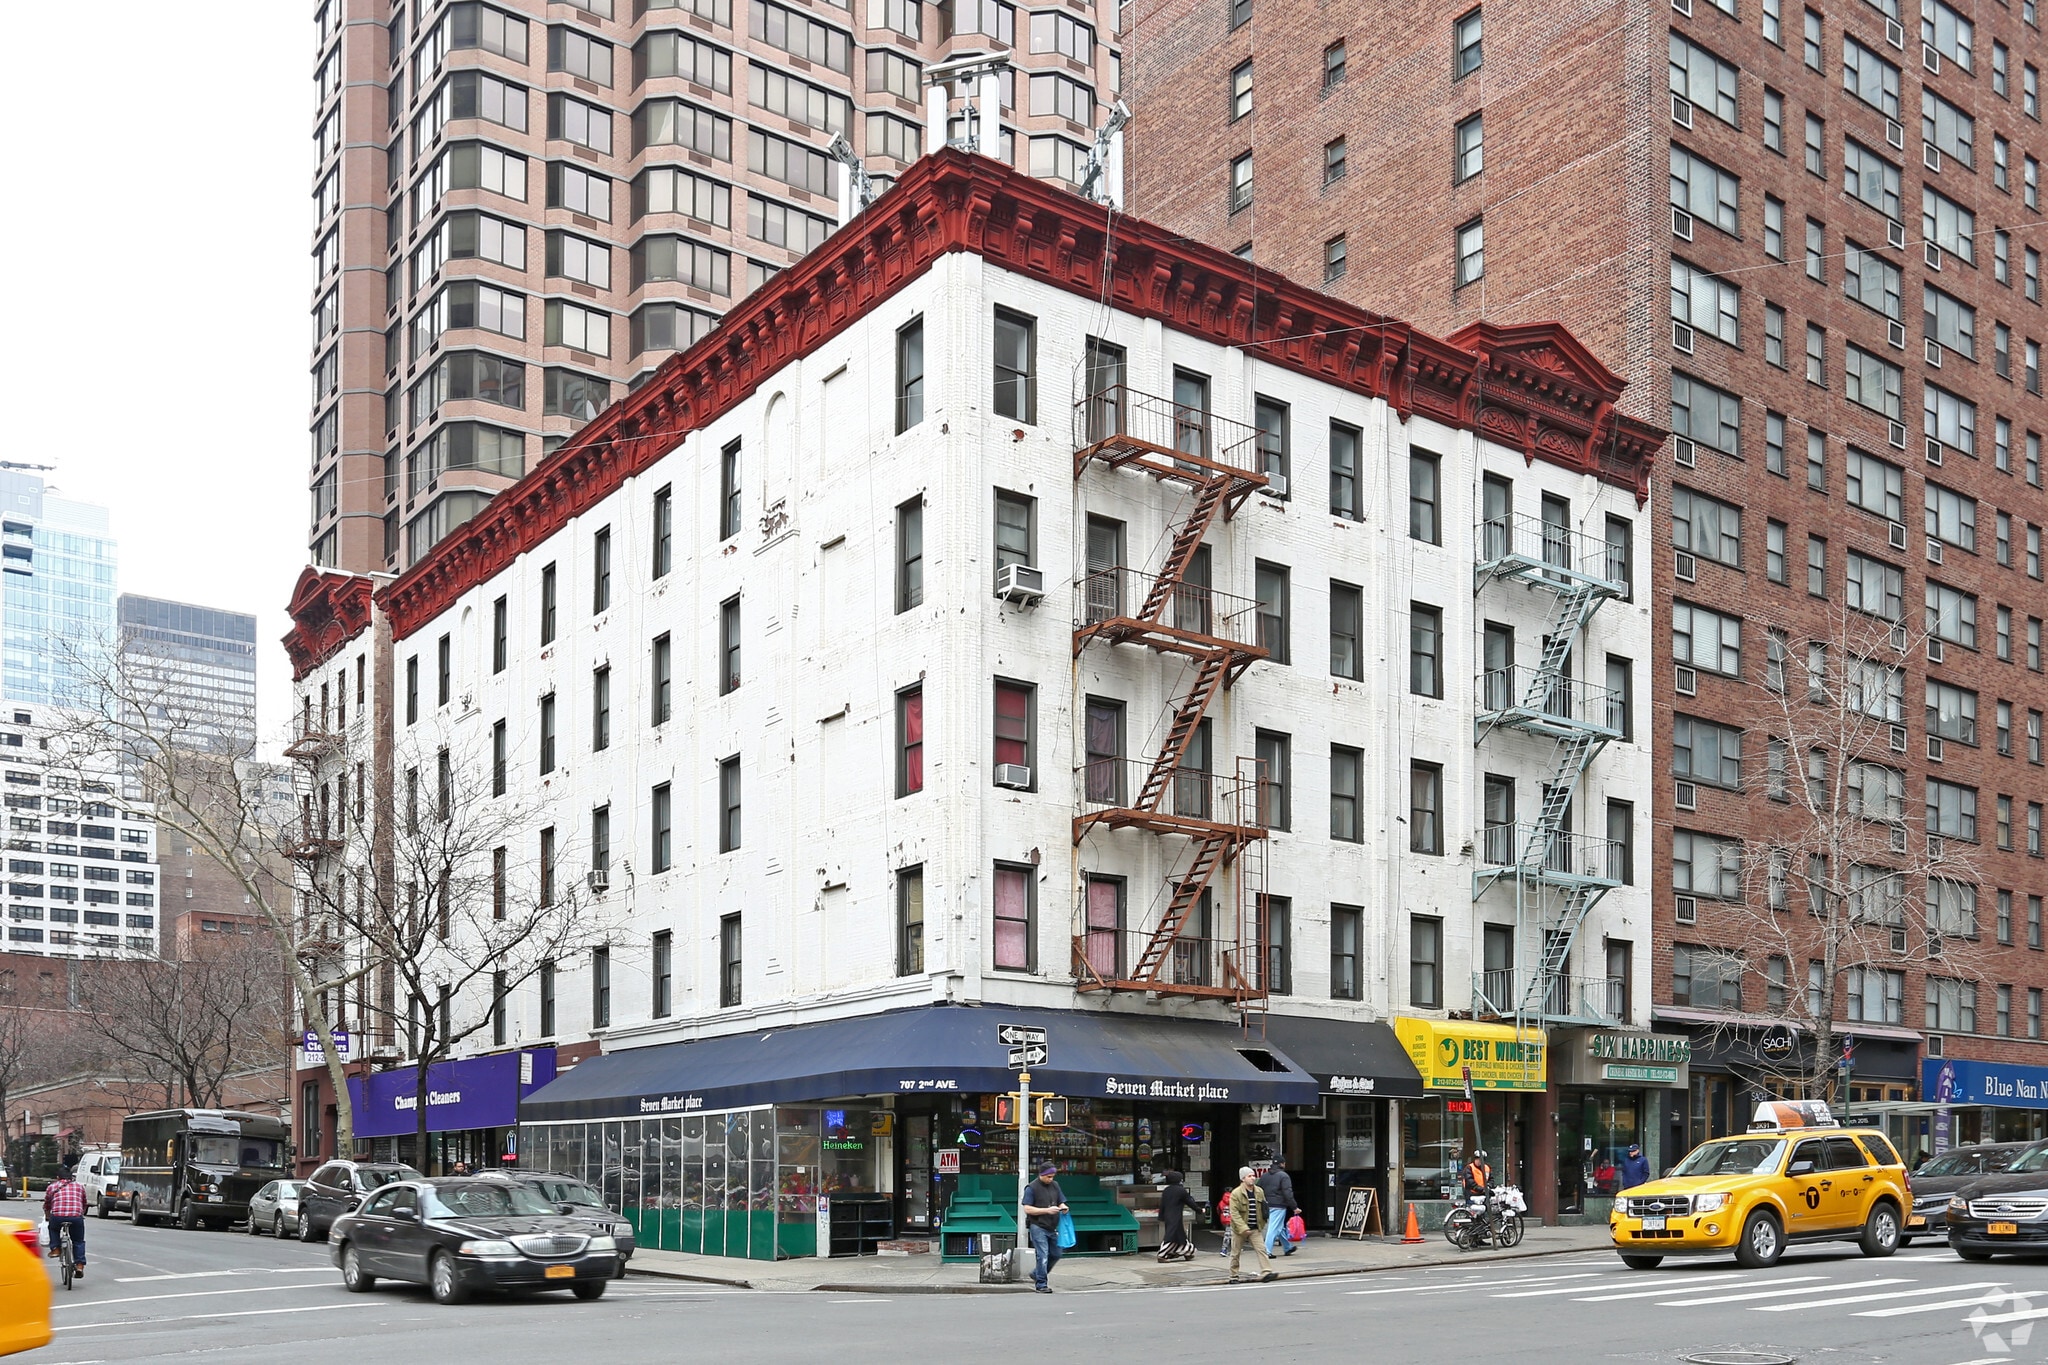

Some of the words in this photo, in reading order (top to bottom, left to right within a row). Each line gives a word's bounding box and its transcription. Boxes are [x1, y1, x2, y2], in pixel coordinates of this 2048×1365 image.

[1004, 1031, 1018, 1040] ONE
[1026, 1032, 1040, 1041] WAY
[1763, 1036, 1792, 1049] SACHI
[1463, 1040, 1489, 1061] BEST
[1590, 1034, 1616, 1058] SIX
[1619, 1037, 1691, 1063] HAPPINESS
[1013, 1054, 1024, 1062] ONE
[900, 1080, 916, 1089] 707
[918, 1079, 934, 1089] 2nd
[935, 1080, 958, 1089] AVE.
[1105, 1077, 1147, 1096] Seven
[1149, 1080, 1195, 1098] Market
[1198, 1082, 1229, 1101] place
[1985, 1076, 2013, 1097] Blue
[2016, 1079, 2037, 1099] Nan
[429, 1091, 461, 1105] Cleaners
[640, 1097, 660, 1112] Seven
[660, 1095, 684, 1111] Market
[684, 1094, 703, 1112] place
[823, 1140, 863, 1150] Heineken
[940, 1153, 958, 1167] ATM
[1350, 1190, 1368, 1204] COME
[1344, 1210, 1363, 1229] SOUP
